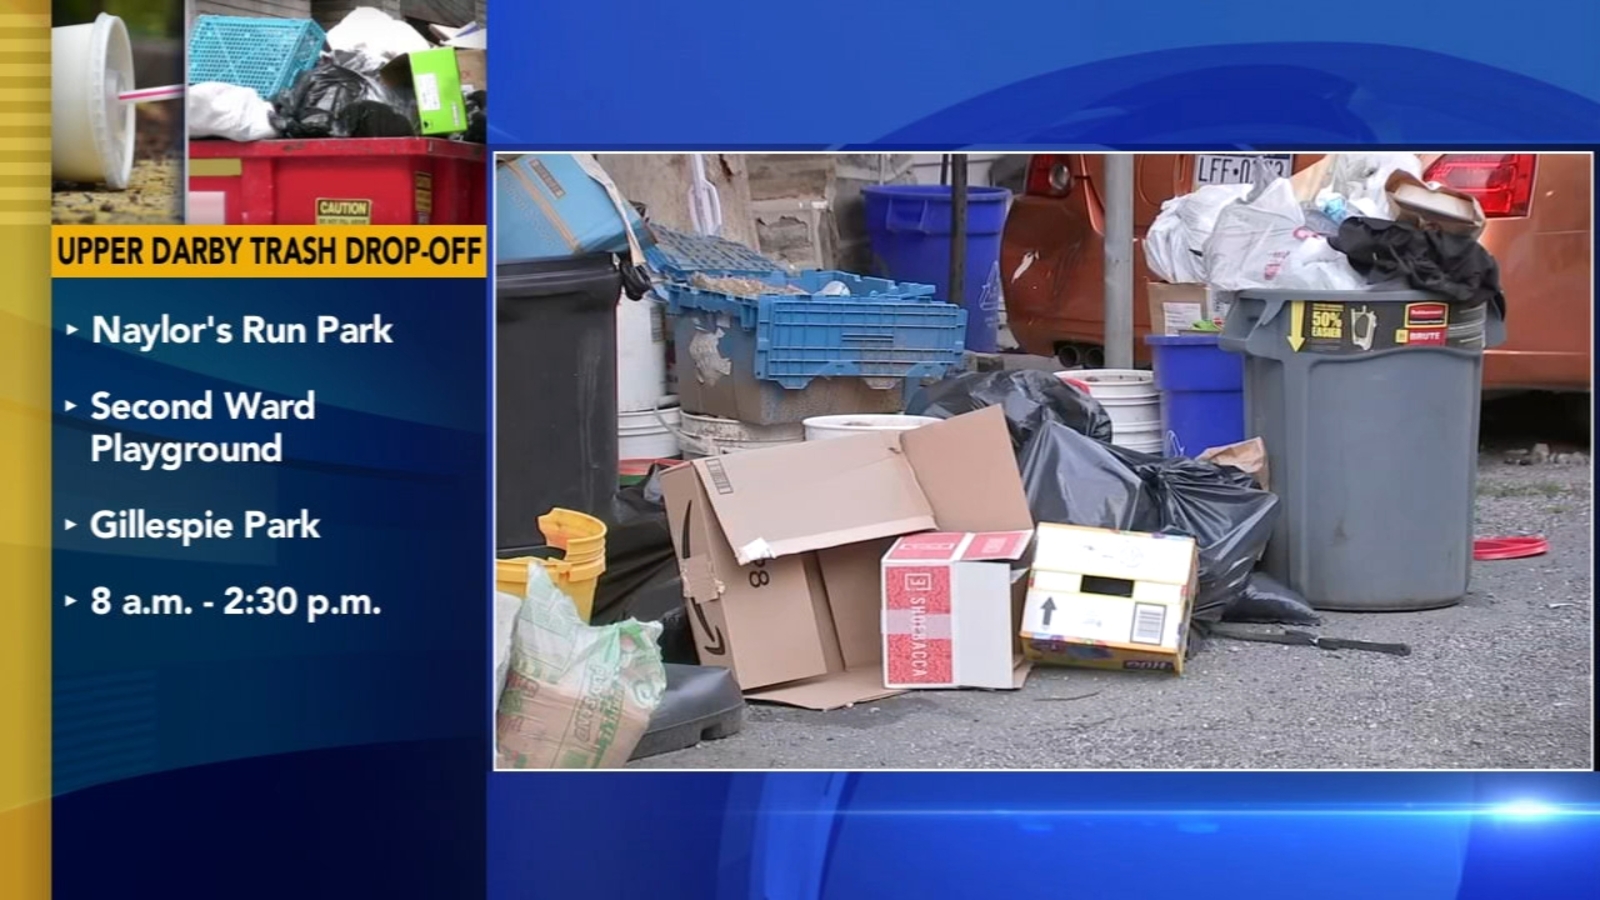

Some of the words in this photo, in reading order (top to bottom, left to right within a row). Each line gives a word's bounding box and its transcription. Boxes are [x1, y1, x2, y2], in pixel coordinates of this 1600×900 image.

[319, 201, 367, 215] CAUTION
[1312, 311, 1342, 327] 50%
[1311, 327, 1342, 339] EASIER
[1409, 329, 1440, 340] BRUTE
[908, 596, 928, 677] SHOEBACCA
